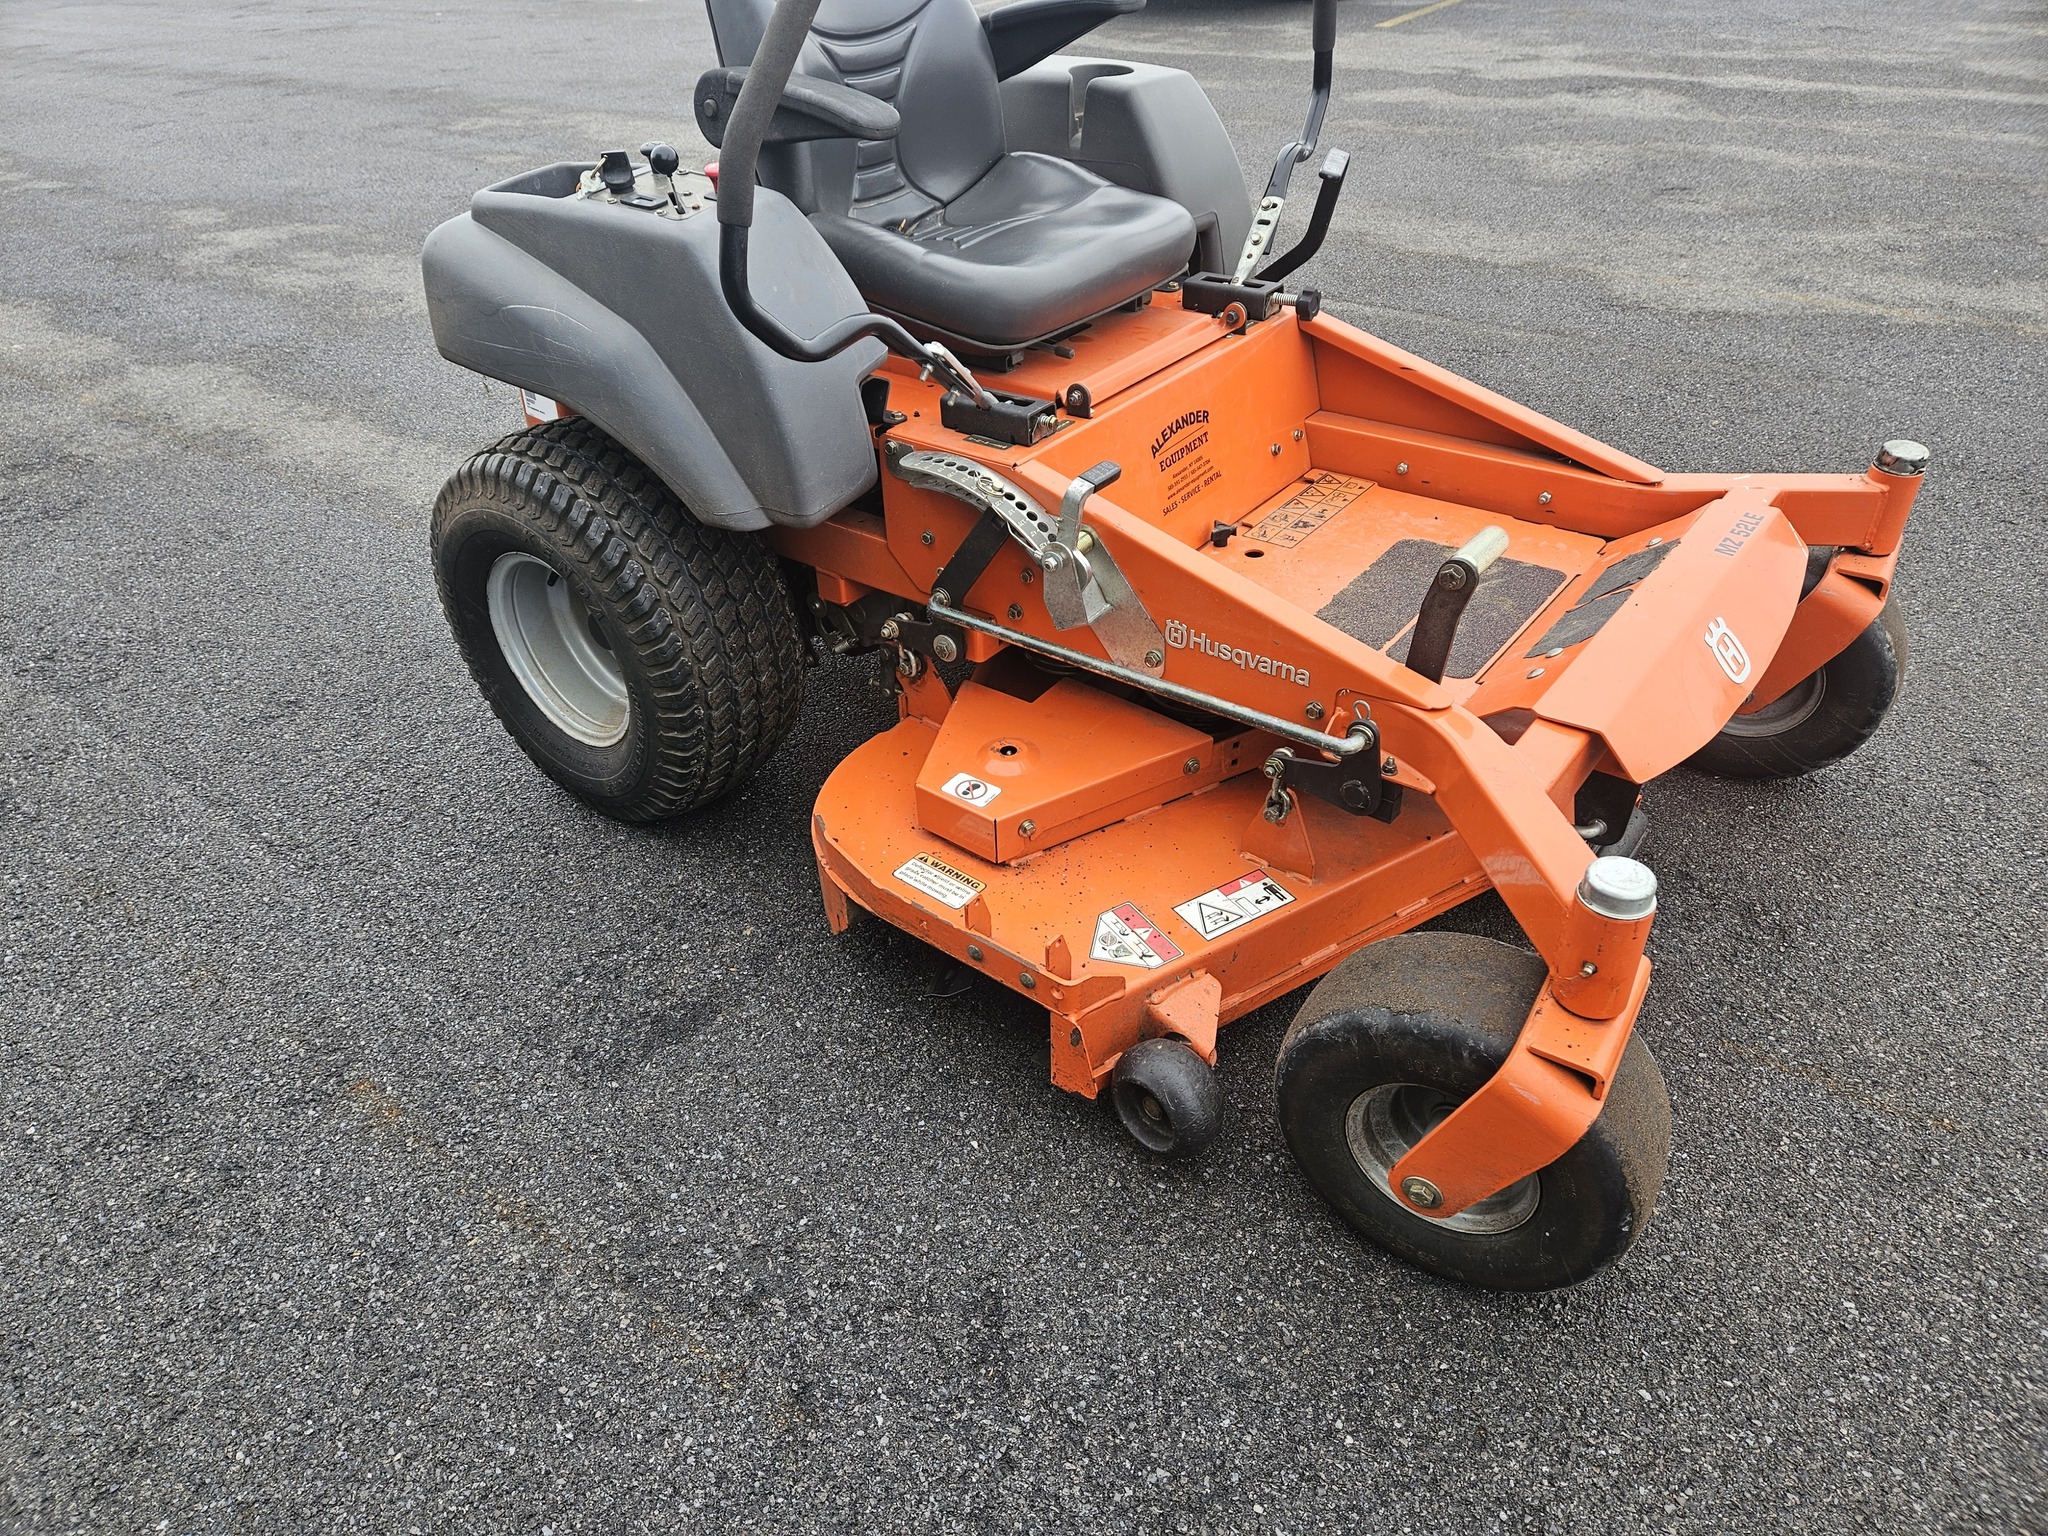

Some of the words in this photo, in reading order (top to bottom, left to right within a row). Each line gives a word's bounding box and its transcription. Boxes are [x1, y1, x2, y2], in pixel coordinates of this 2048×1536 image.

[1151, 409, 1210, 460] ALEXANDER
[1159, 431, 1209, 473] EQUIPMENT
[1162, 500, 1178, 517] SALES
[1180, 484, 1201, 504] SERVICE
[1203, 469, 1222, 488] RENTAL
[1713, 536, 1744, 557] MZ
[1729, 511, 1765, 538] 52LE
[1189, 629, 1311, 687] Husqvarna
[898, 869, 914, 881] place
[913, 876, 928, 887] while
[911, 861, 935, 876] Deflector
[934, 873, 950, 885] shield
[919, 873, 938, 886] catcher
[937, 883, 953, 893] must
[930, 859, 981, 890] WARNING
